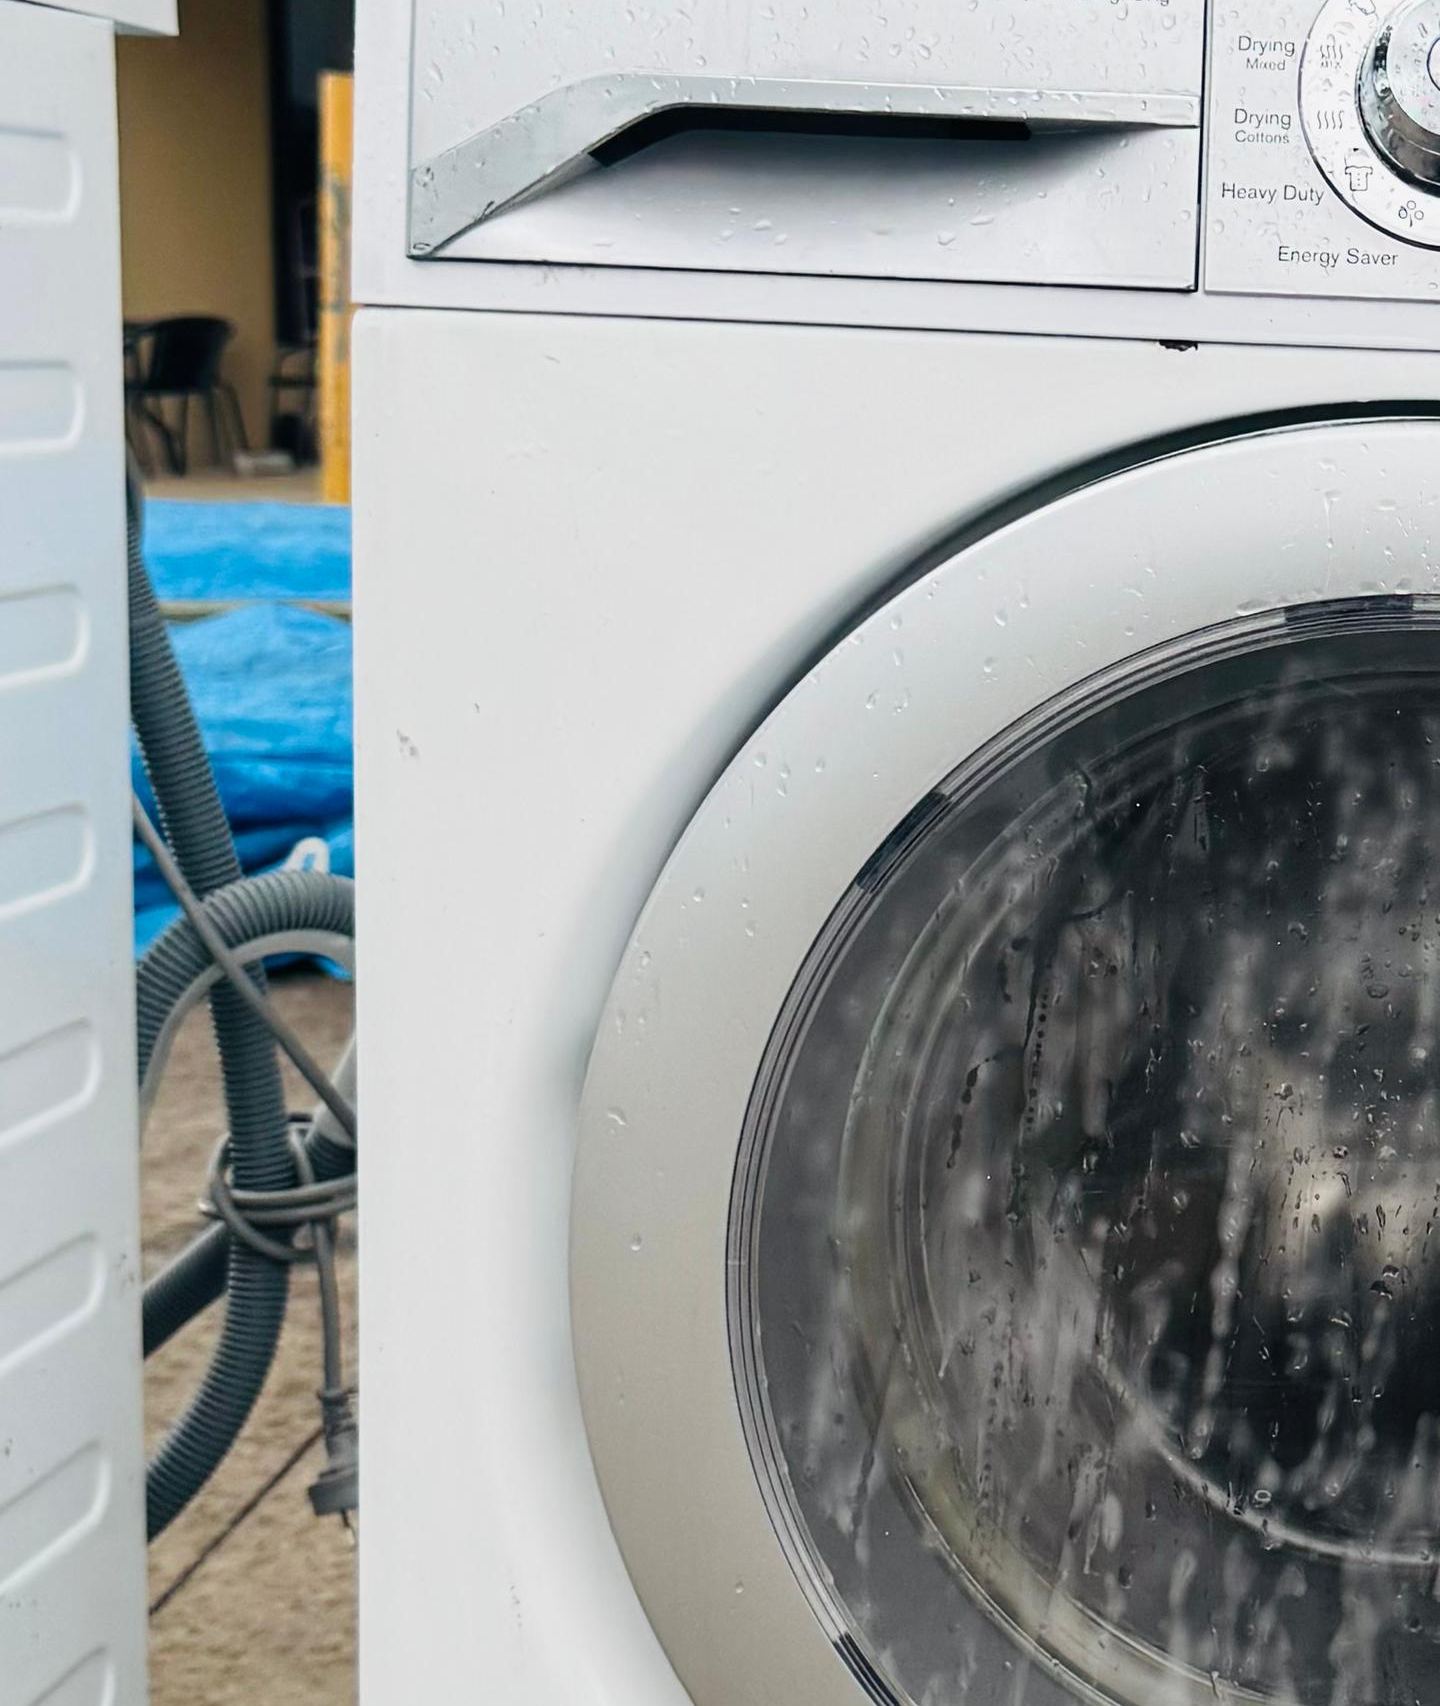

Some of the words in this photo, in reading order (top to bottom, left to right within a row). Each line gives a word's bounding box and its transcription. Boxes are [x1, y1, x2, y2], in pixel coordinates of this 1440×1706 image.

[1237, 35, 1296, 57] Drying
[1234, 108, 1292, 130] Drying
[1235, 130, 1290, 144] Cottons
[1221, 182, 1277, 204] Heavy
[1283, 184, 1325, 206] Duty
[1278, 246, 1340, 268] Energy
[1346, 248, 1398, 266] Saver
